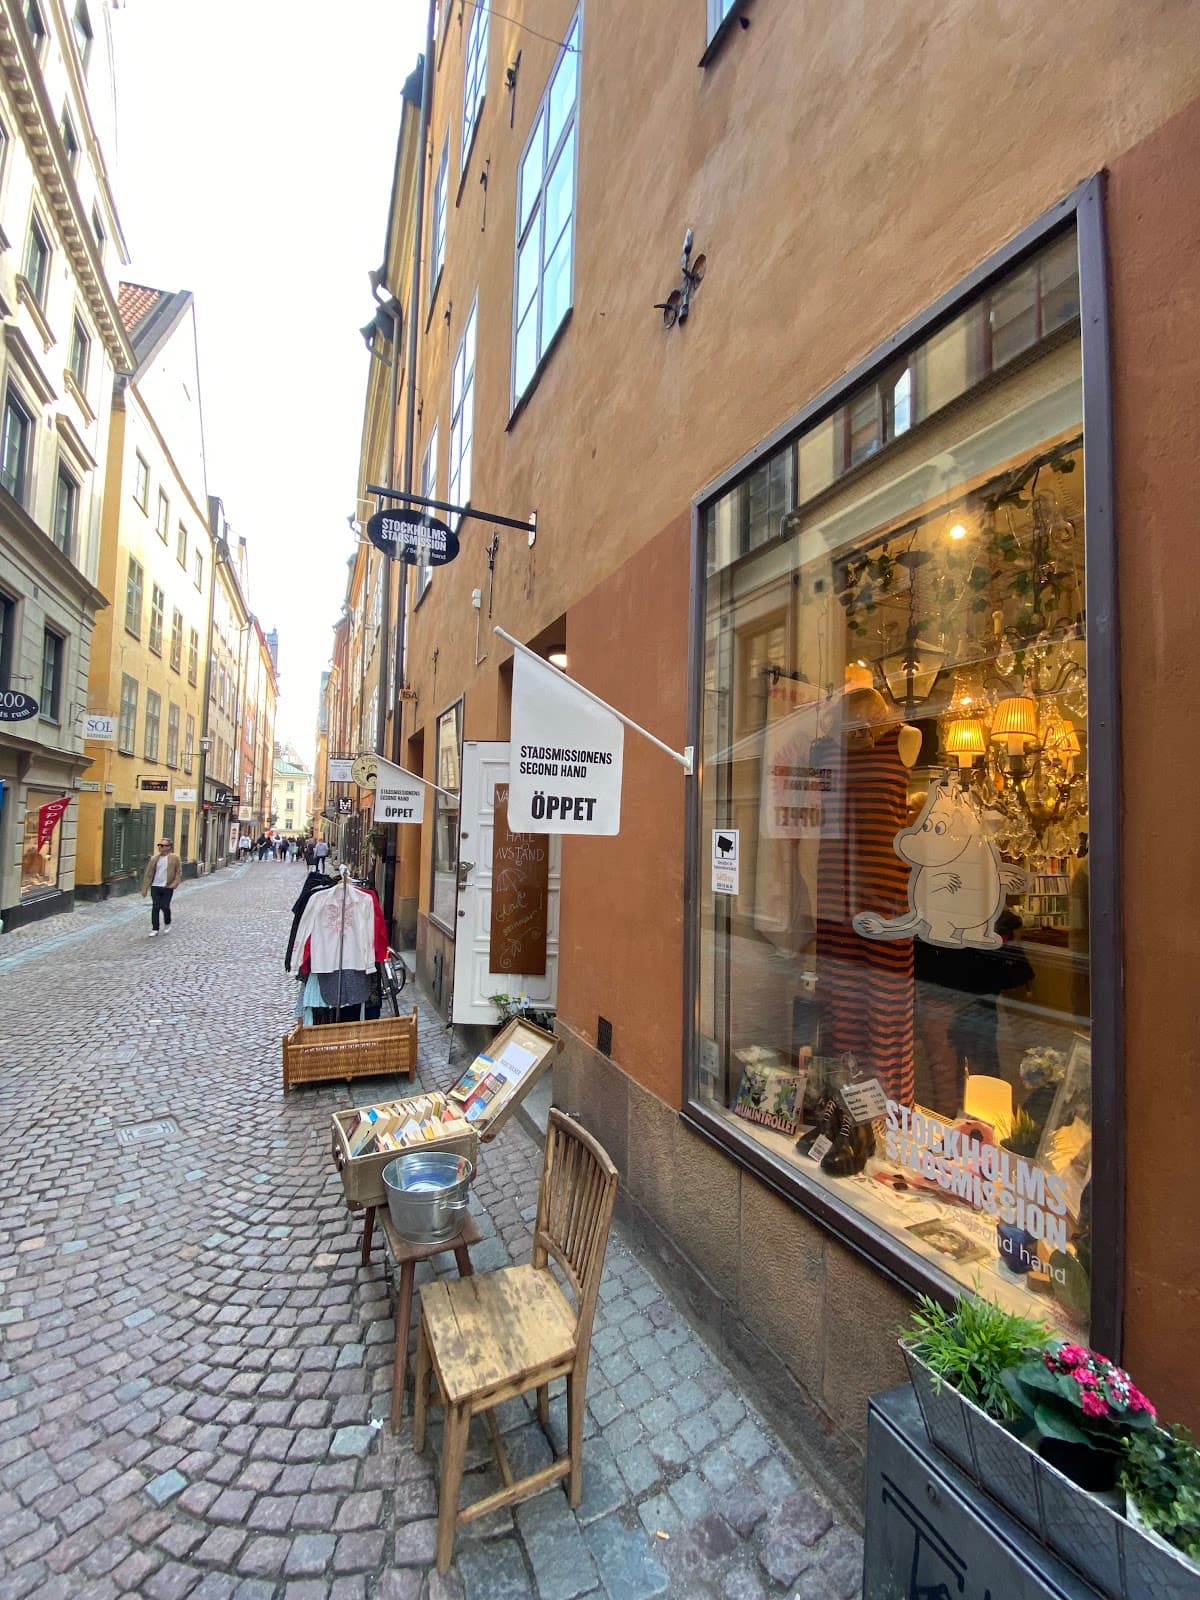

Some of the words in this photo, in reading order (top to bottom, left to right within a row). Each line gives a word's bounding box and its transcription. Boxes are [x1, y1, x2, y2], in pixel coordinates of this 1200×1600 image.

[381, 517, 447, 542] STOCKHOLMS
[381, 529, 447, 552] STADSMISSION
[11, 708, 31, 718] rum
[87, 719, 113, 733] SOL
[520, 745, 613, 765] STADSMISSIONENS
[519, 762, 558, 776] SECOND
[560, 765, 588, 778] HAND
[385, 804, 414, 818] ÖPPET
[531, 790, 598, 822] ÖPPET
[41, 804, 63, 842] ÖPPET
[734, 1103, 798, 1136] MUMINTROLLET
[885, 1099, 1067, 1216] STOCKHOLMS
[885, 1130, 1067, 1255] STADSMISSION
[1019, 1243, 1066, 1285] hand
